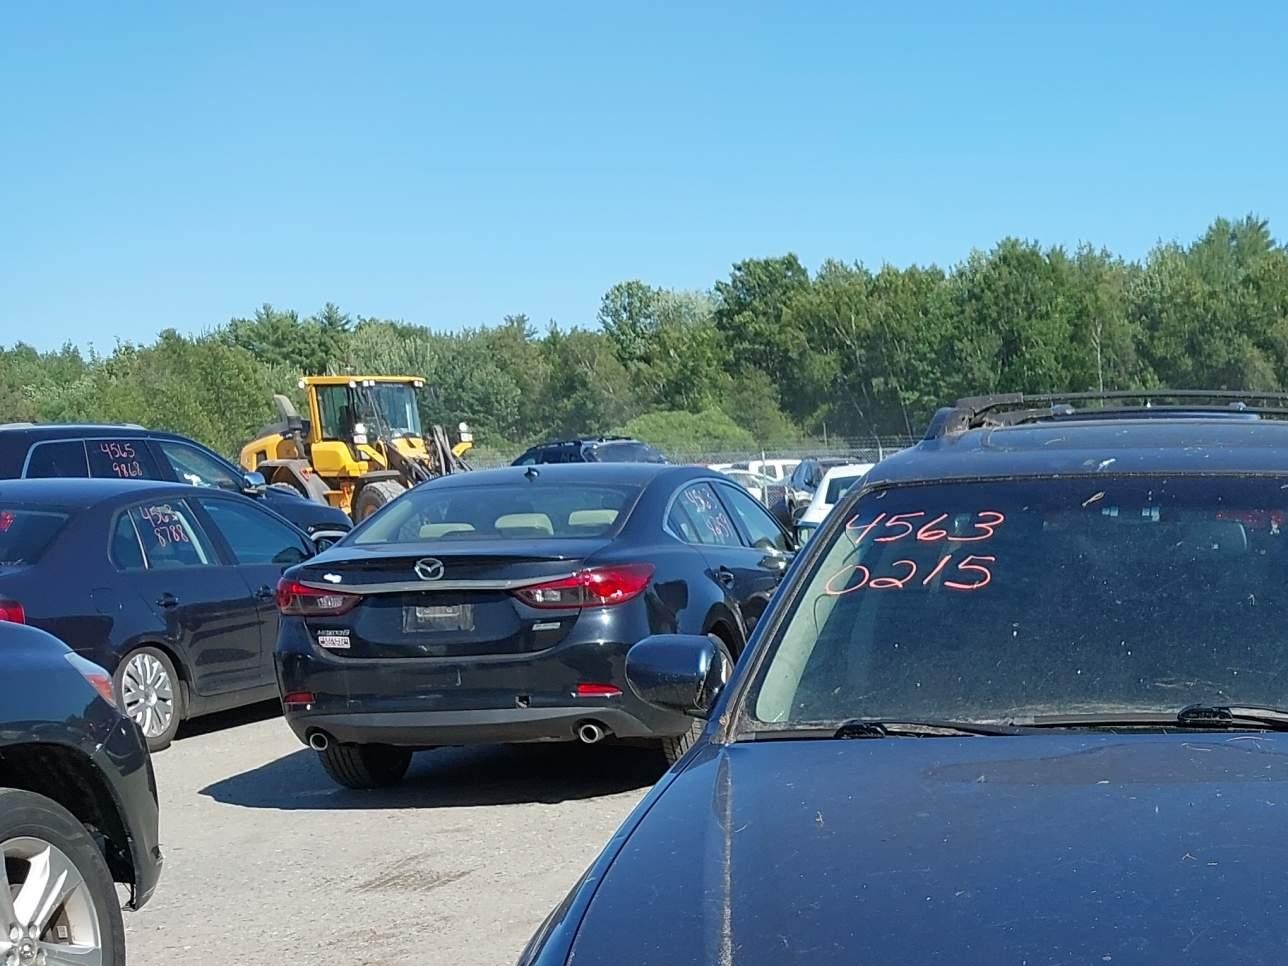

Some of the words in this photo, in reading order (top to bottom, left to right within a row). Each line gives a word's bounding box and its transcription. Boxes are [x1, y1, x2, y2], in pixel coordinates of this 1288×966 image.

[100, 442, 135, 460] 4565
[112, 461, 143, 478] 9868
[153, 524, 189, 547] 8788
[845, 511, 1005, 544] 4563
[825, 554, 997, 595] 0215
